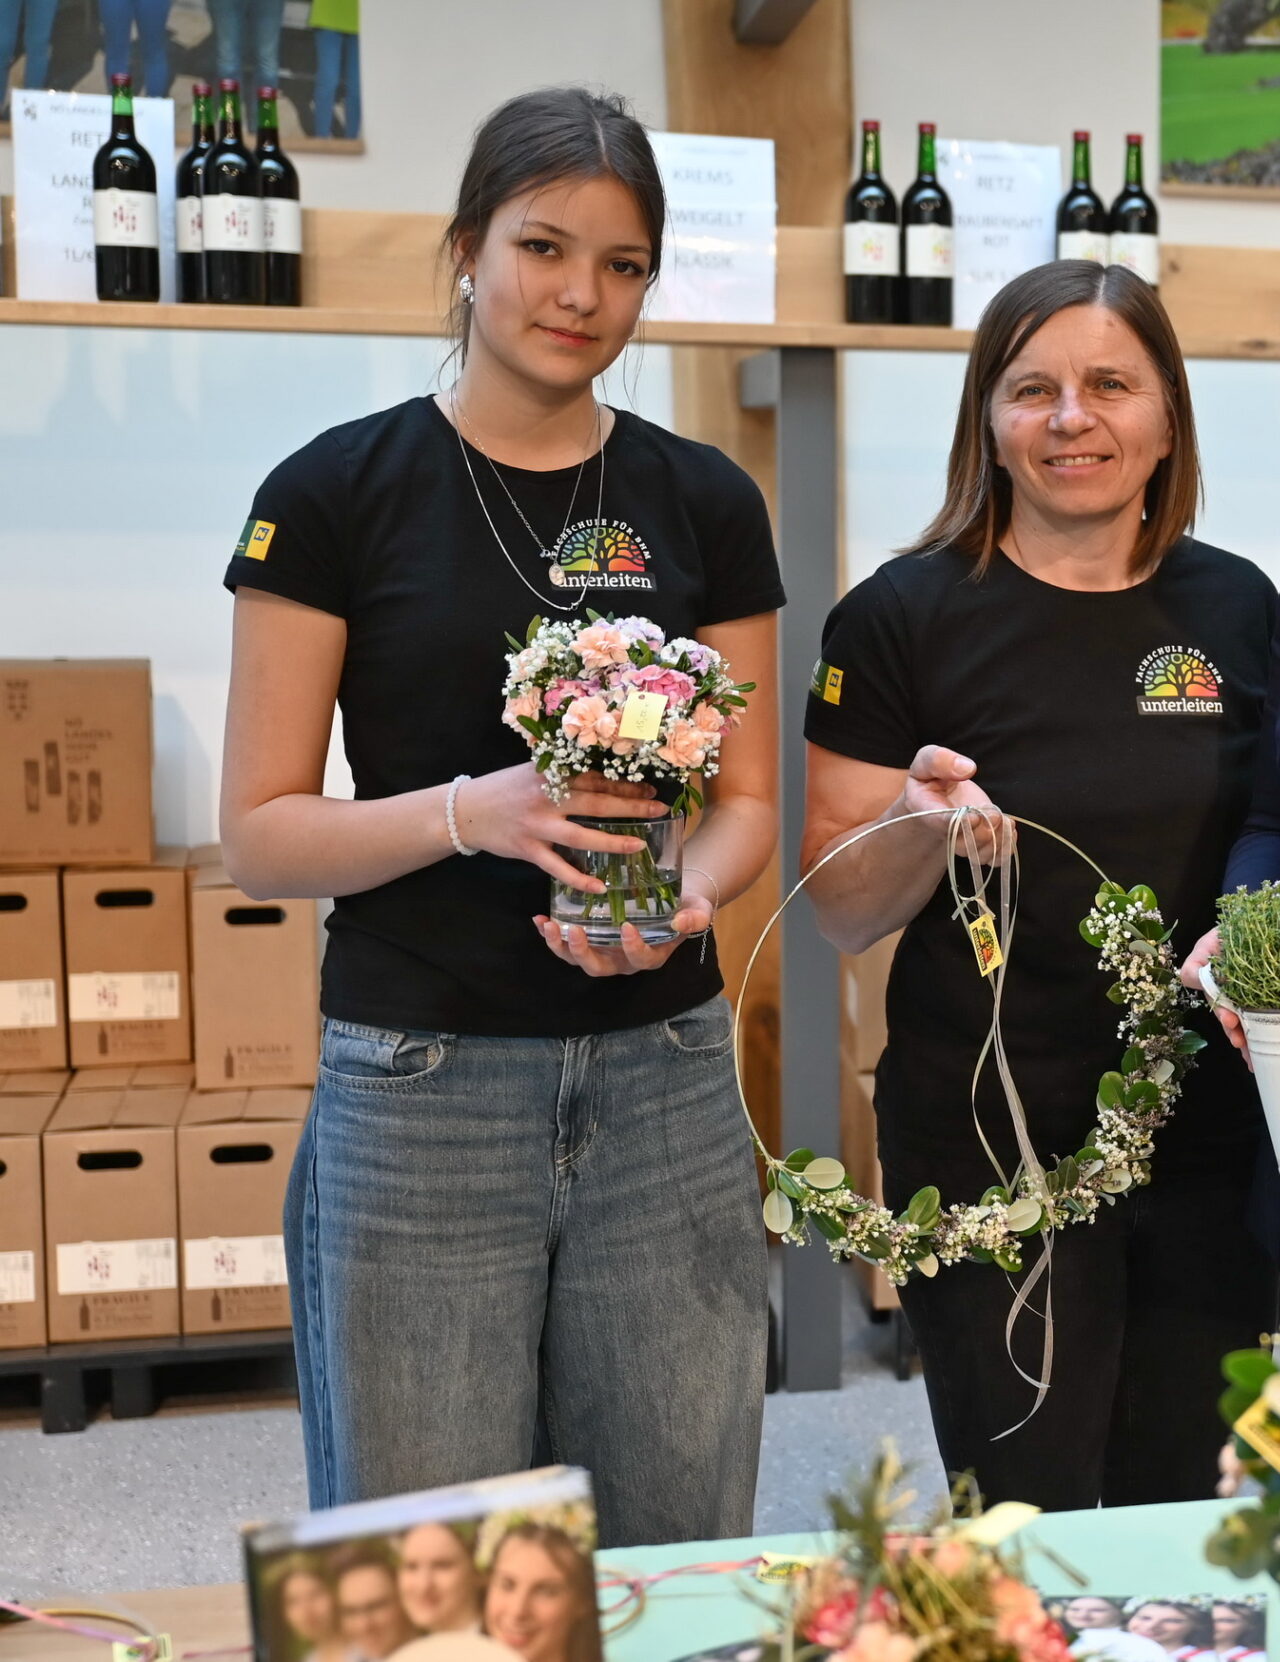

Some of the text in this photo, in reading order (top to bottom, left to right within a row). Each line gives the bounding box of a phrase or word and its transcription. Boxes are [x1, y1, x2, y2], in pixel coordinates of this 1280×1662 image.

[672, 168, 735, 186] KREMS
[976, 175, 1015, 193] RETZ
[668, 208, 745, 227] WEIGELT
[955, 214, 1044, 231] RAUBENSAFT
[551, 518, 608, 557] FACHSCHULE
[1135, 645, 1184, 684] FACHSCHULE
[1140, 697, 1224, 714] unterleiten
